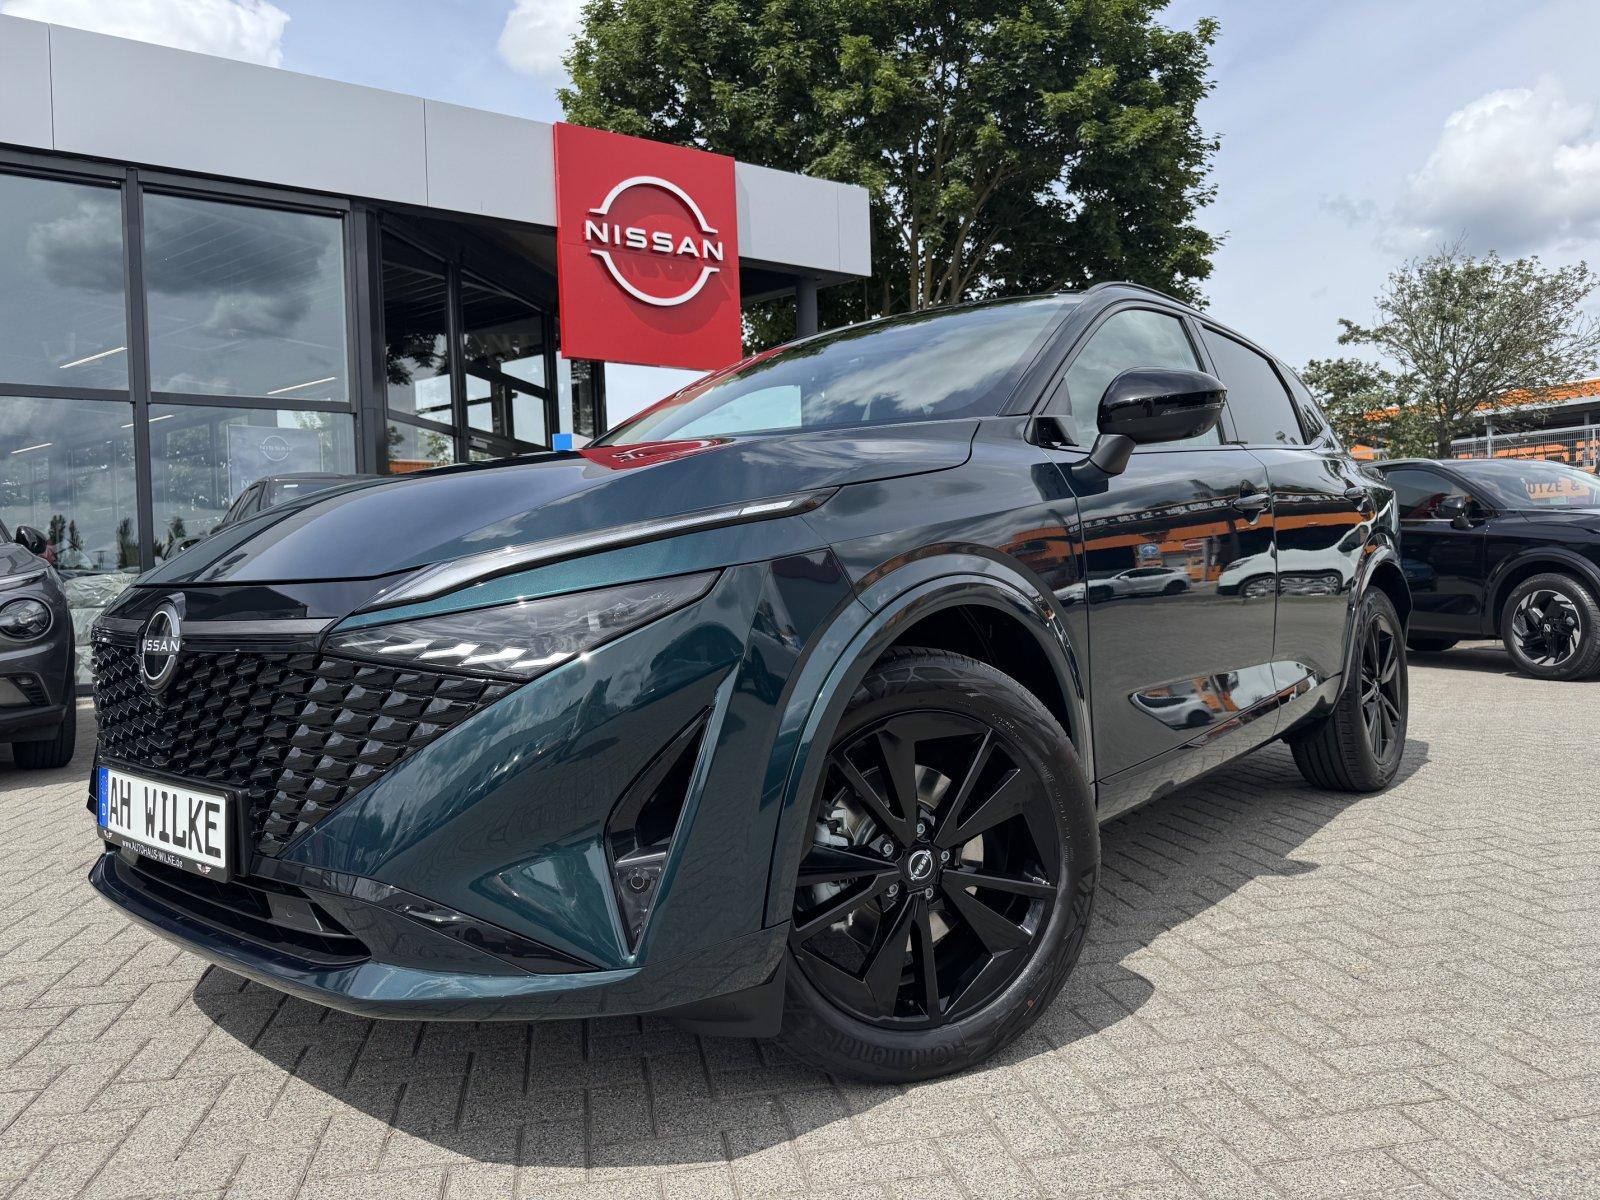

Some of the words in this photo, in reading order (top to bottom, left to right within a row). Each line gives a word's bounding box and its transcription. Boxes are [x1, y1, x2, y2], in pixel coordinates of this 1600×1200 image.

[584, 219, 723, 261] NISSAN
[110, 776, 132, 830] AH
[144, 786, 222, 859] WILKE
